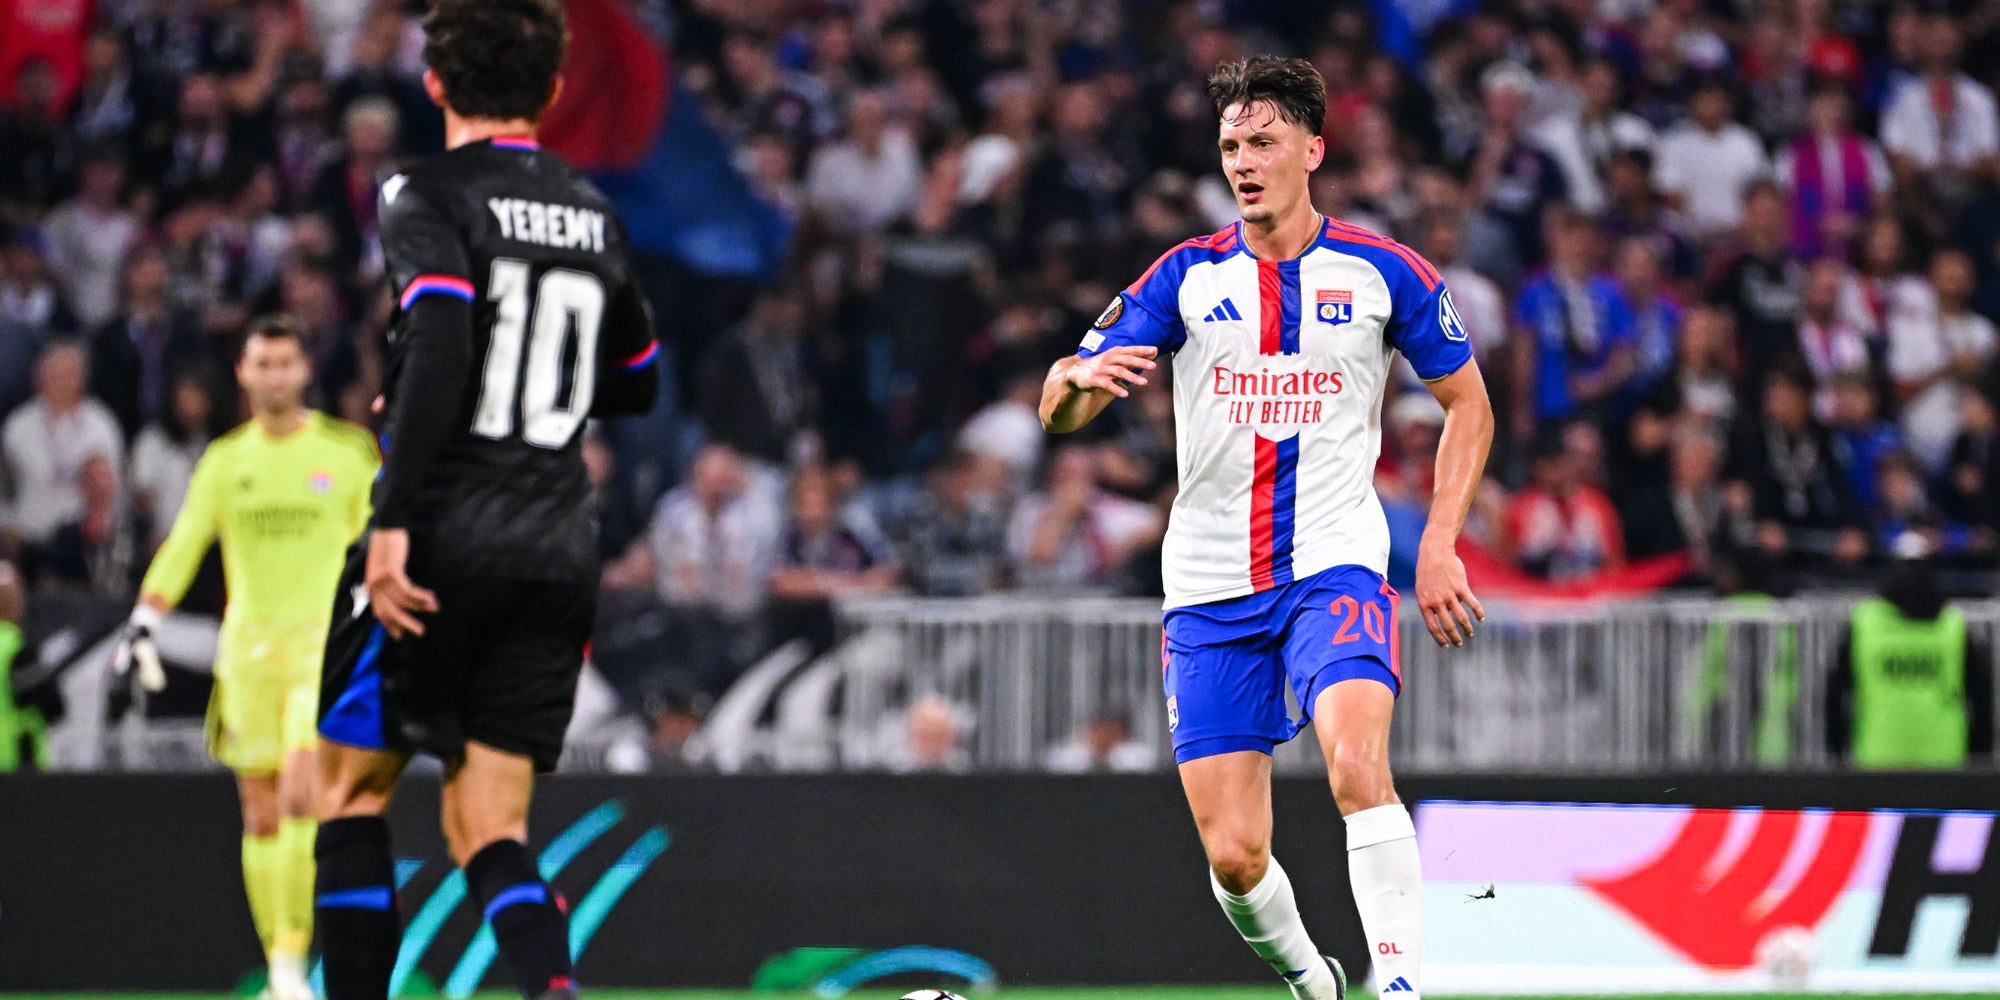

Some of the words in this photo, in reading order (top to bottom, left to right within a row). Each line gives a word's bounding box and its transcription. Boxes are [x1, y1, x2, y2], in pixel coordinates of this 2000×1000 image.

[488, 197, 605, 253] YEREMY
[470, 256, 606, 449] 10
[1213, 366, 1343, 396] Emirates
[1228, 401, 1255, 424] FLY
[1260, 400, 1322, 424] BETTER
[1330, 594, 1386, 646] 20
[1378, 942, 1403, 955] OL
